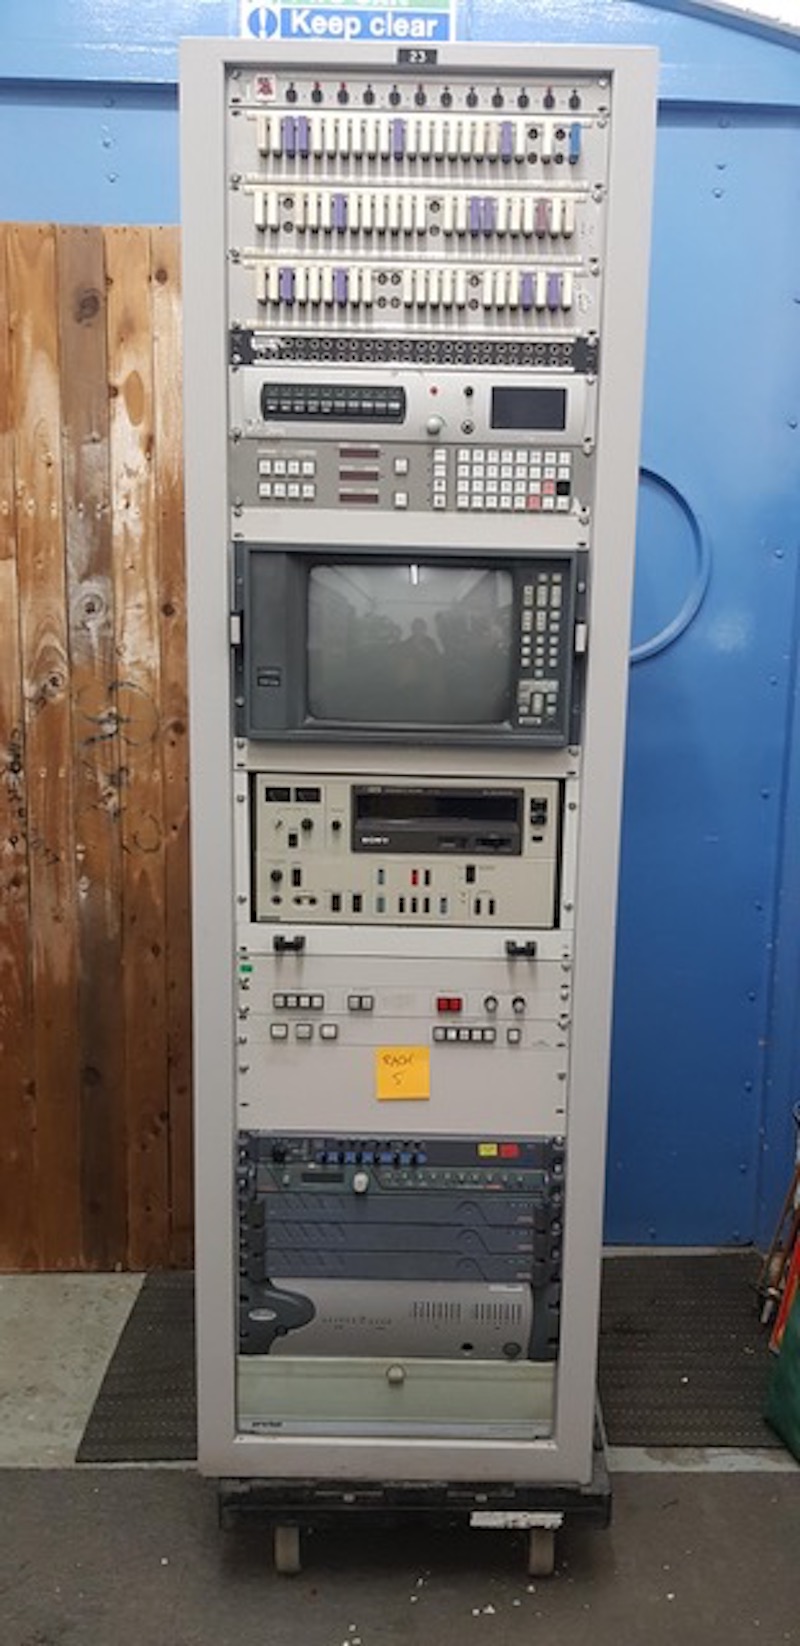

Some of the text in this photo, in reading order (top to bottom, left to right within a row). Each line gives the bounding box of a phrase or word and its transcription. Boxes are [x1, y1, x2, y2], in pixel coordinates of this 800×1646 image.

[291, 9, 438, 39] Keep clear
[410, 51, 426, 63] 23
